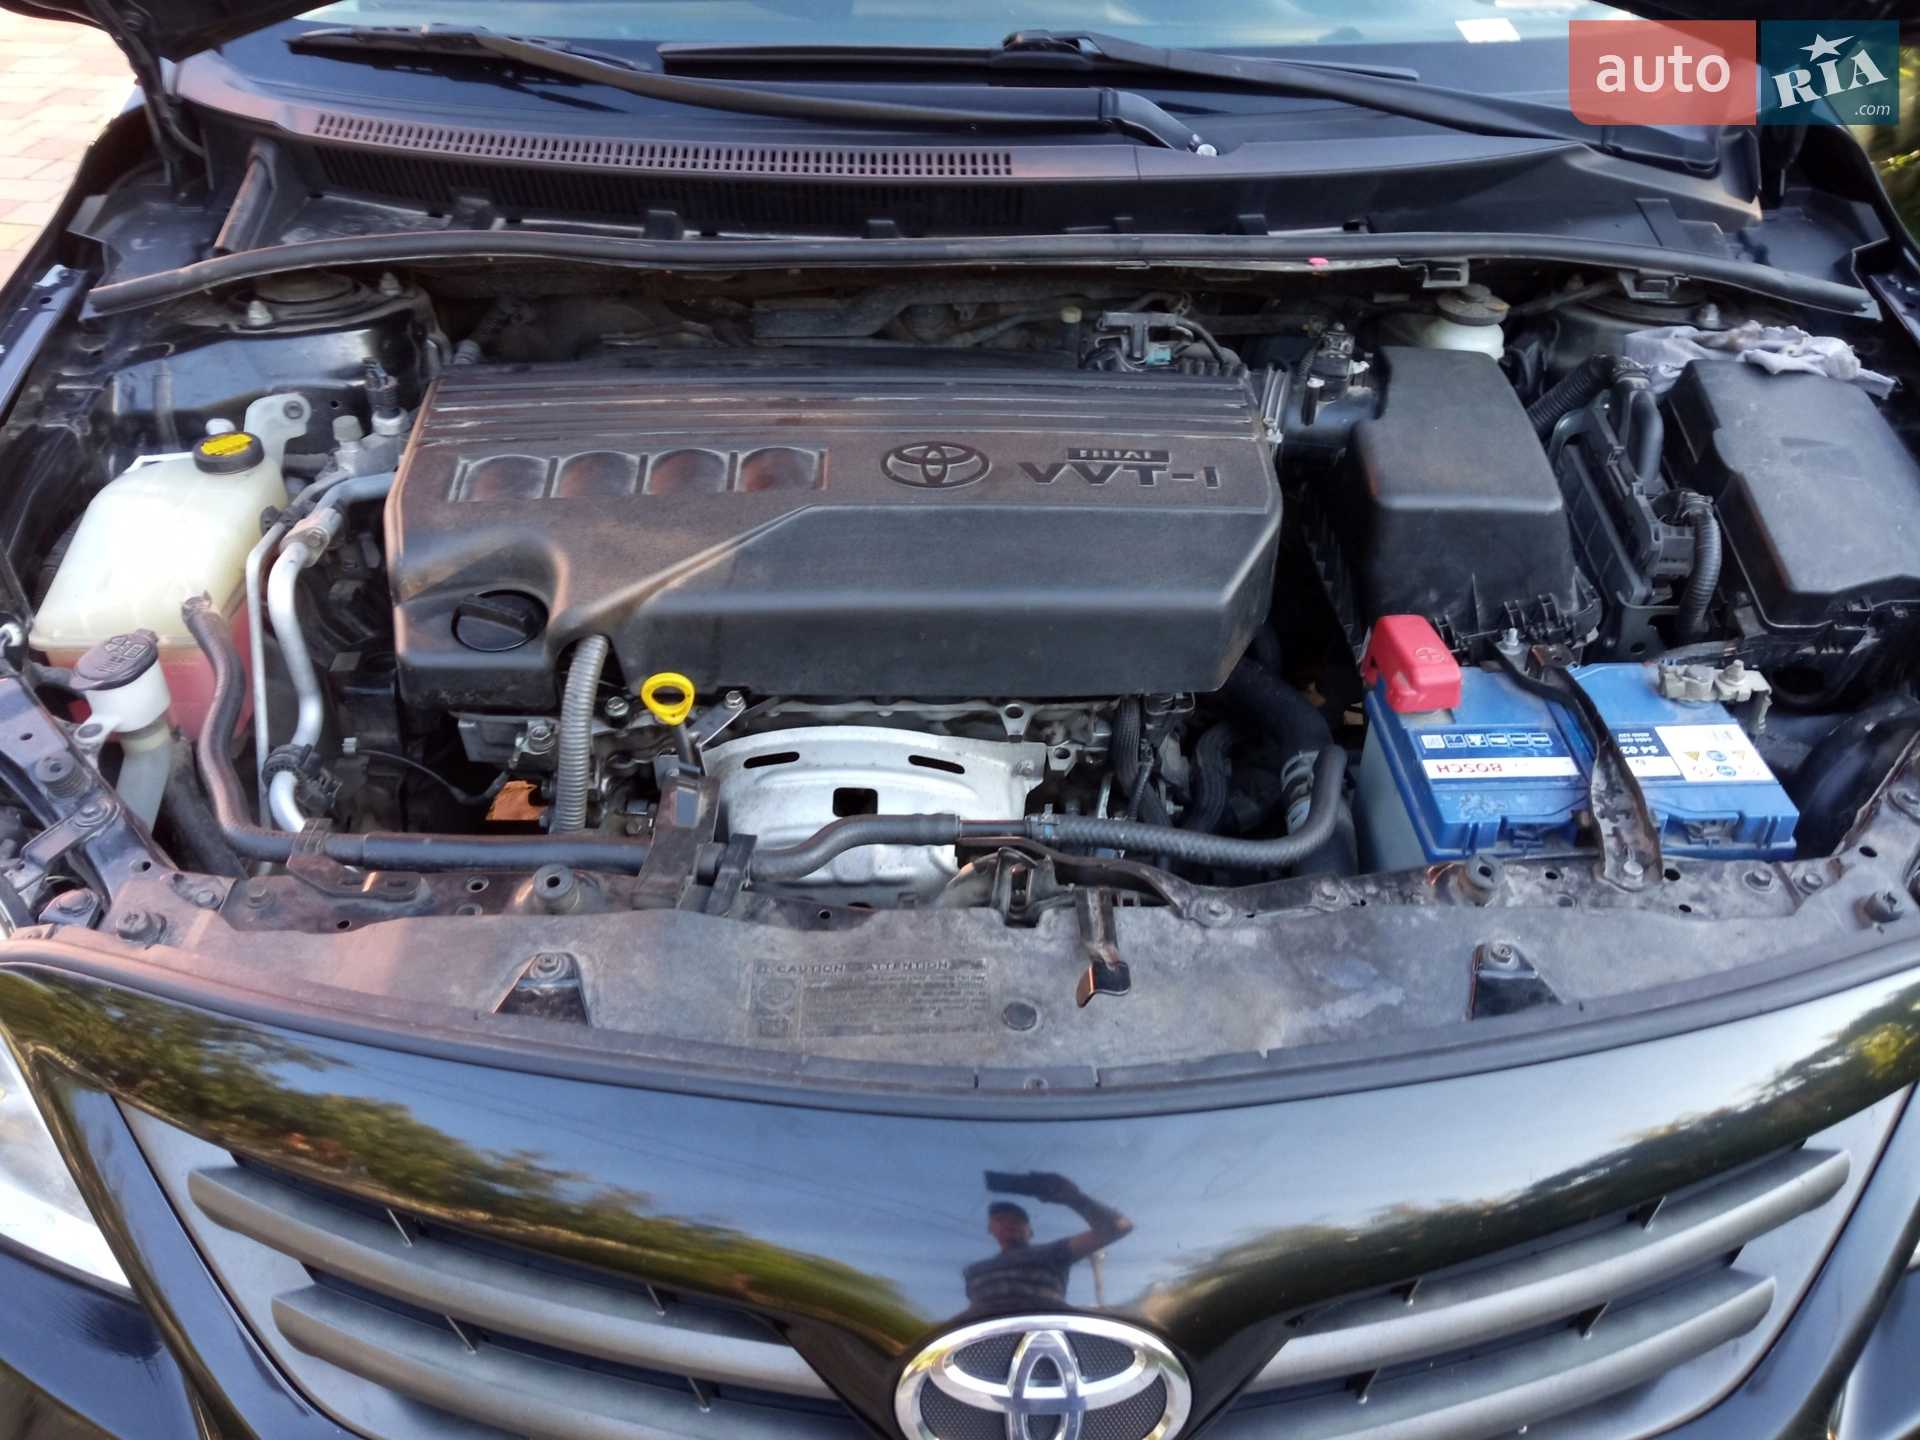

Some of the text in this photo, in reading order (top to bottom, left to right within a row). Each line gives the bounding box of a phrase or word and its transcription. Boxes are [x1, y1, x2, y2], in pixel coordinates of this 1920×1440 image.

[1436, 762, 1503, 773] BOSCH
[776, 960, 950, 974] CAUTION ATTENTION
